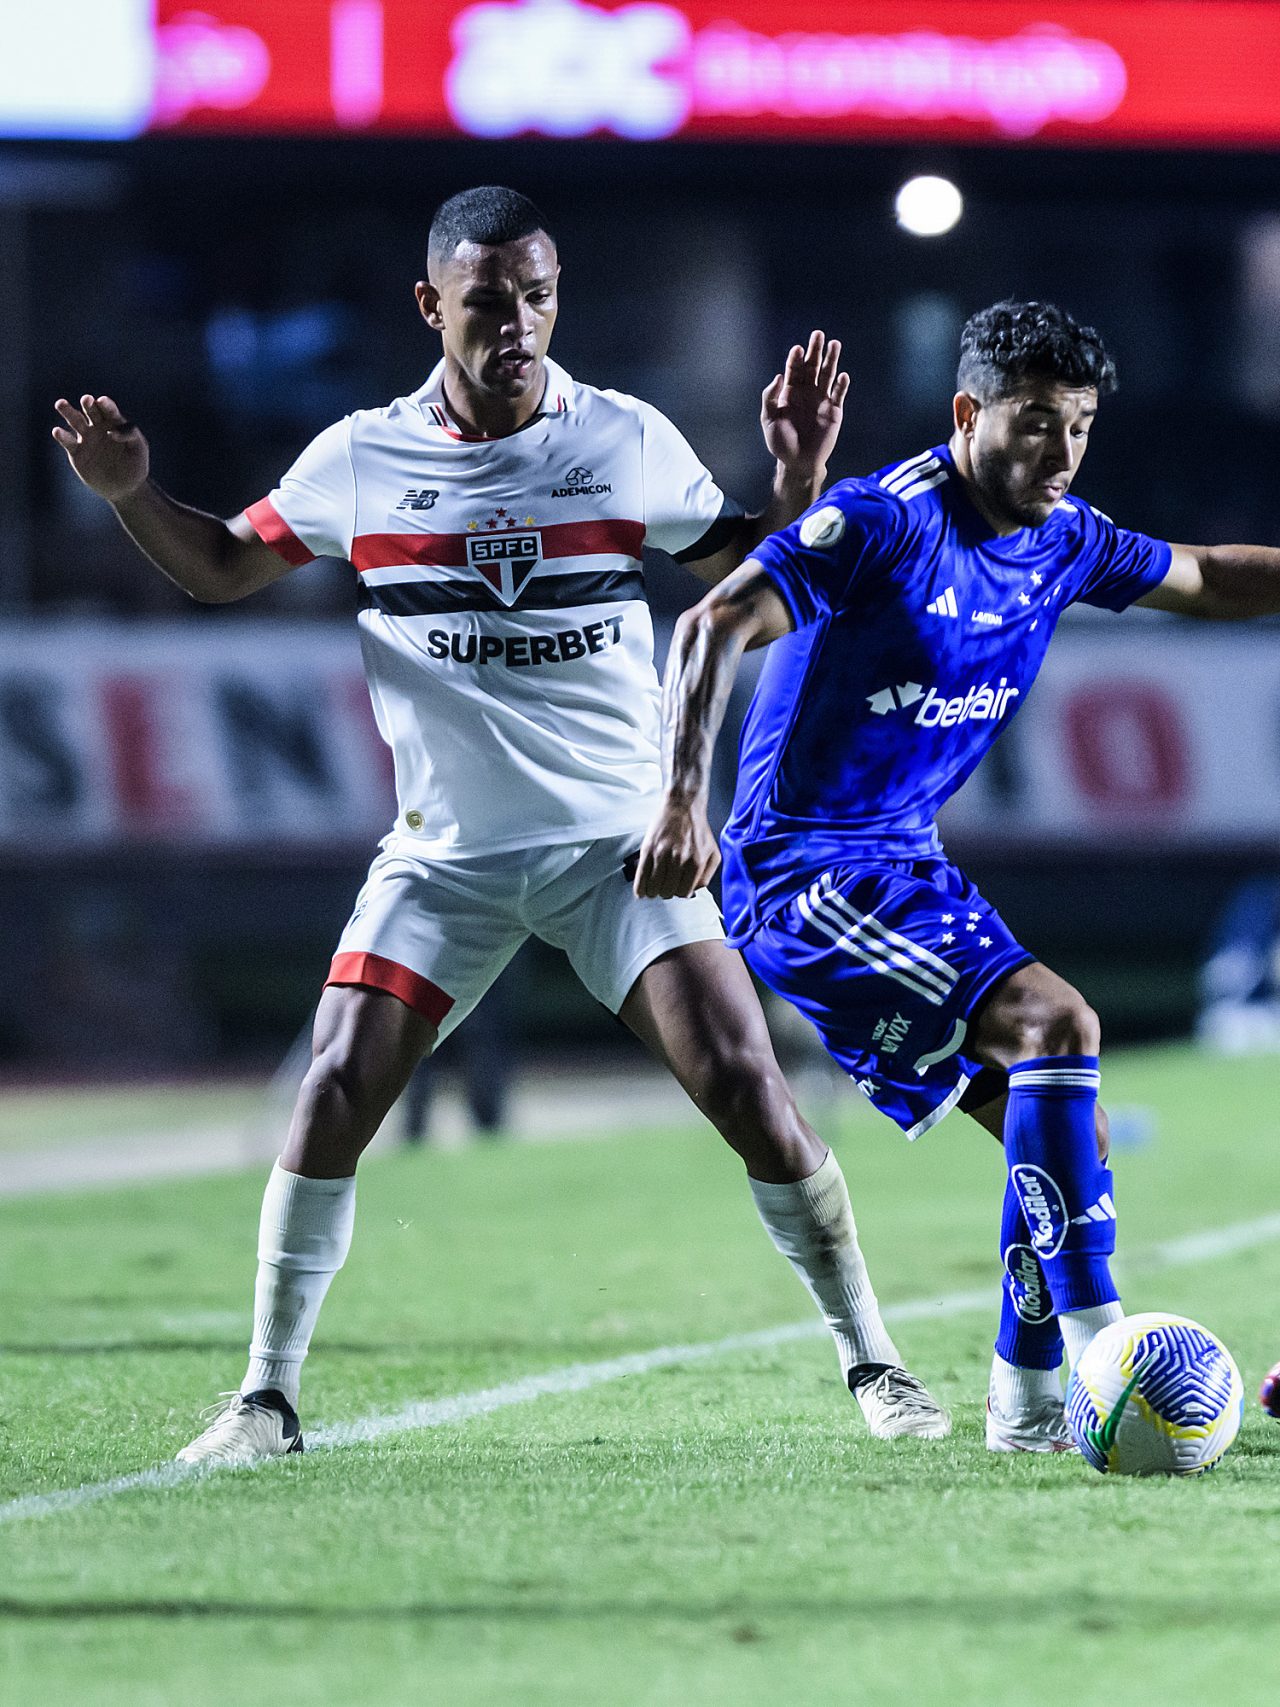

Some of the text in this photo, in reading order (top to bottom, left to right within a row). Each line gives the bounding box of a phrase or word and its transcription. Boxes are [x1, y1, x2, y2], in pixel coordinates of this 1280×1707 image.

[551, 483, 613, 499] ADEMICON
[474, 539, 535, 558] SPFC
[427, 616, 625, 668] SUPERBET
[914, 677, 1020, 728] betfair
[1017, 1171, 1055, 1248] Kodilar
